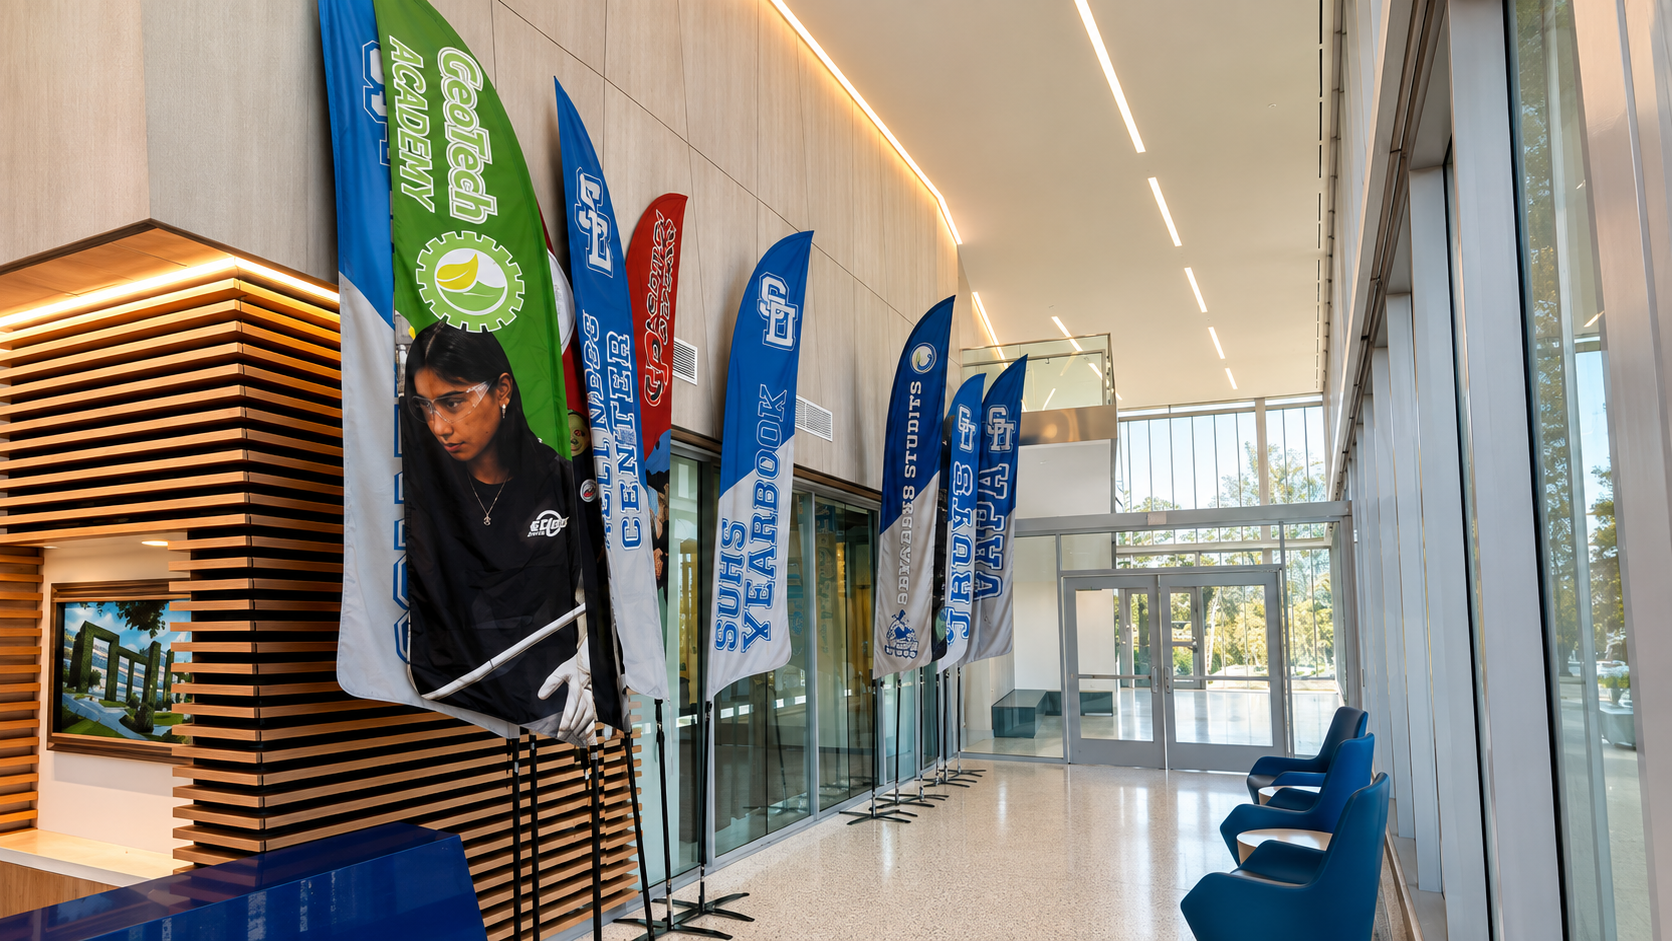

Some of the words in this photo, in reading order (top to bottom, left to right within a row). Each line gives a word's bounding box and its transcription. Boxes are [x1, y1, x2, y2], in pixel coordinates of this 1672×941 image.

[389, 35, 435, 213] ACADEMY
[437, 47, 498, 225] GeoTech
[606, 331, 642, 550] CENTER
[740, 384, 788, 653] YEARBOOK
[715, 518, 748, 652] SUHS
